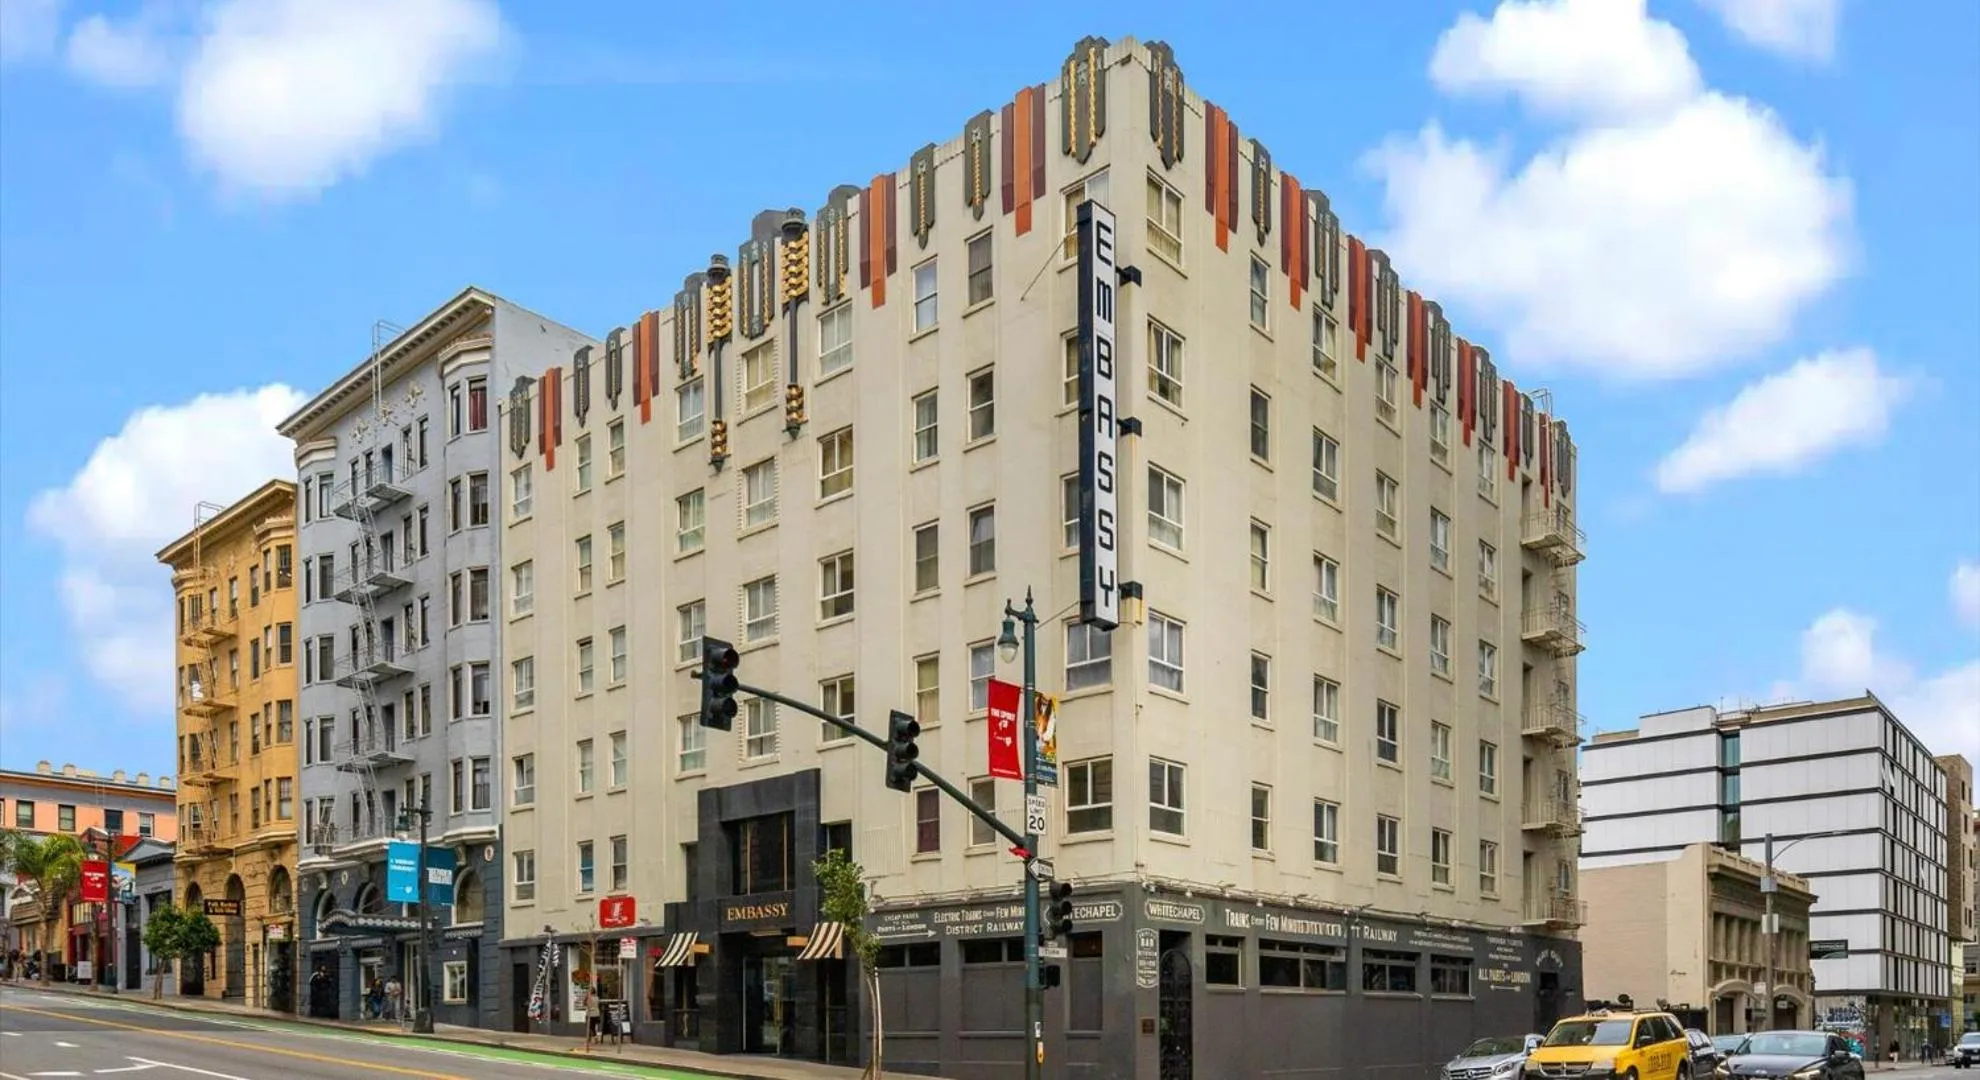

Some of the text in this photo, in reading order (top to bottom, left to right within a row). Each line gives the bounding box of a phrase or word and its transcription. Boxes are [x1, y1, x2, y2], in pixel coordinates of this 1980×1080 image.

[1095, 219, 1115, 609] EMBASSY
[1028, 798, 1045, 808] SPEED
[1029, 815, 1045, 831] 20
[727, 902, 789, 921] EMBASSY
[934, 911, 960, 924] ELECTRIC
[996, 906, 1010, 919] FEW
[1149, 903, 1201, 920] WHITECHAPEL
[1225, 908, 1251, 929] TRAINS
[1265, 914, 1280, 932] FEW
[945, 921, 1025, 936] DISTRICT RAILWAY
[1363, 925, 1398, 942] RAILWAY
[1478, 968, 1488, 980] ALL
[1511, 971, 1531, 984] LONDON
